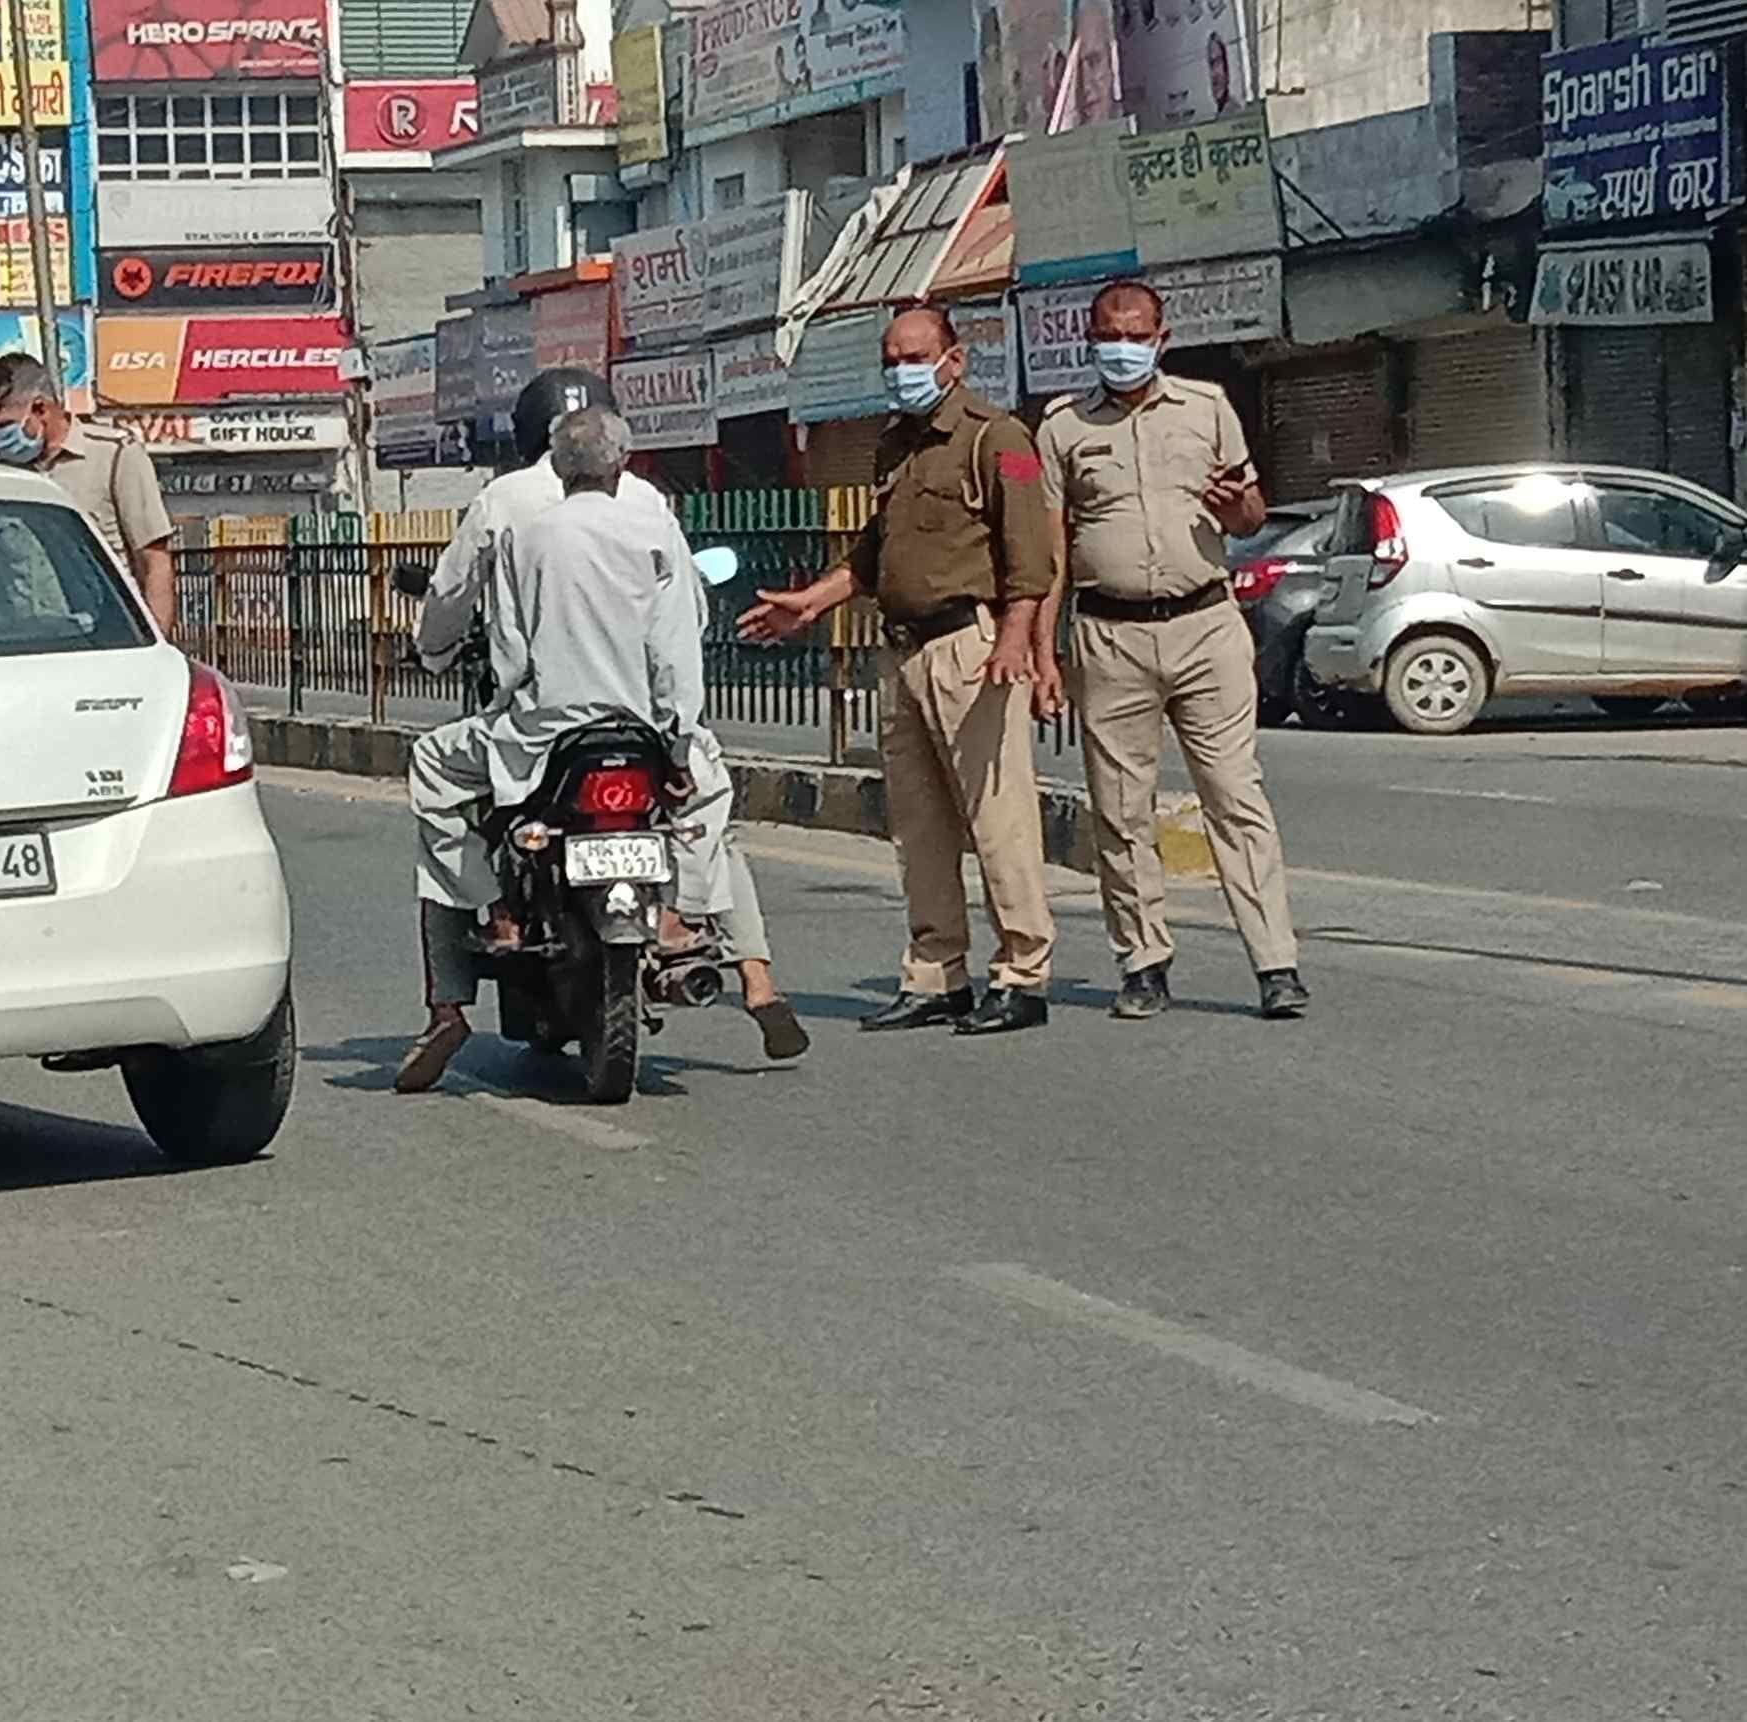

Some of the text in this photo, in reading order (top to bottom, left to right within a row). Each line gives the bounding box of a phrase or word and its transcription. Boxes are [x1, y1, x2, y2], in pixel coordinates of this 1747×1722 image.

[127, 22, 205, 45] HERO
[1543, 50, 1718, 133] Sparsh car
[1128, 131, 1263, 196] कूलर ही कूलर
[1600, 145, 1718, 222] स्पर्श कार
[632, 228, 691, 290] शर्मा
[163, 261, 322, 289] FIREFOX
[109, 351, 167, 370] BSA
[190, 347, 341, 370] HERCULES
[209, 426, 317, 442] GIFT HOUSE
